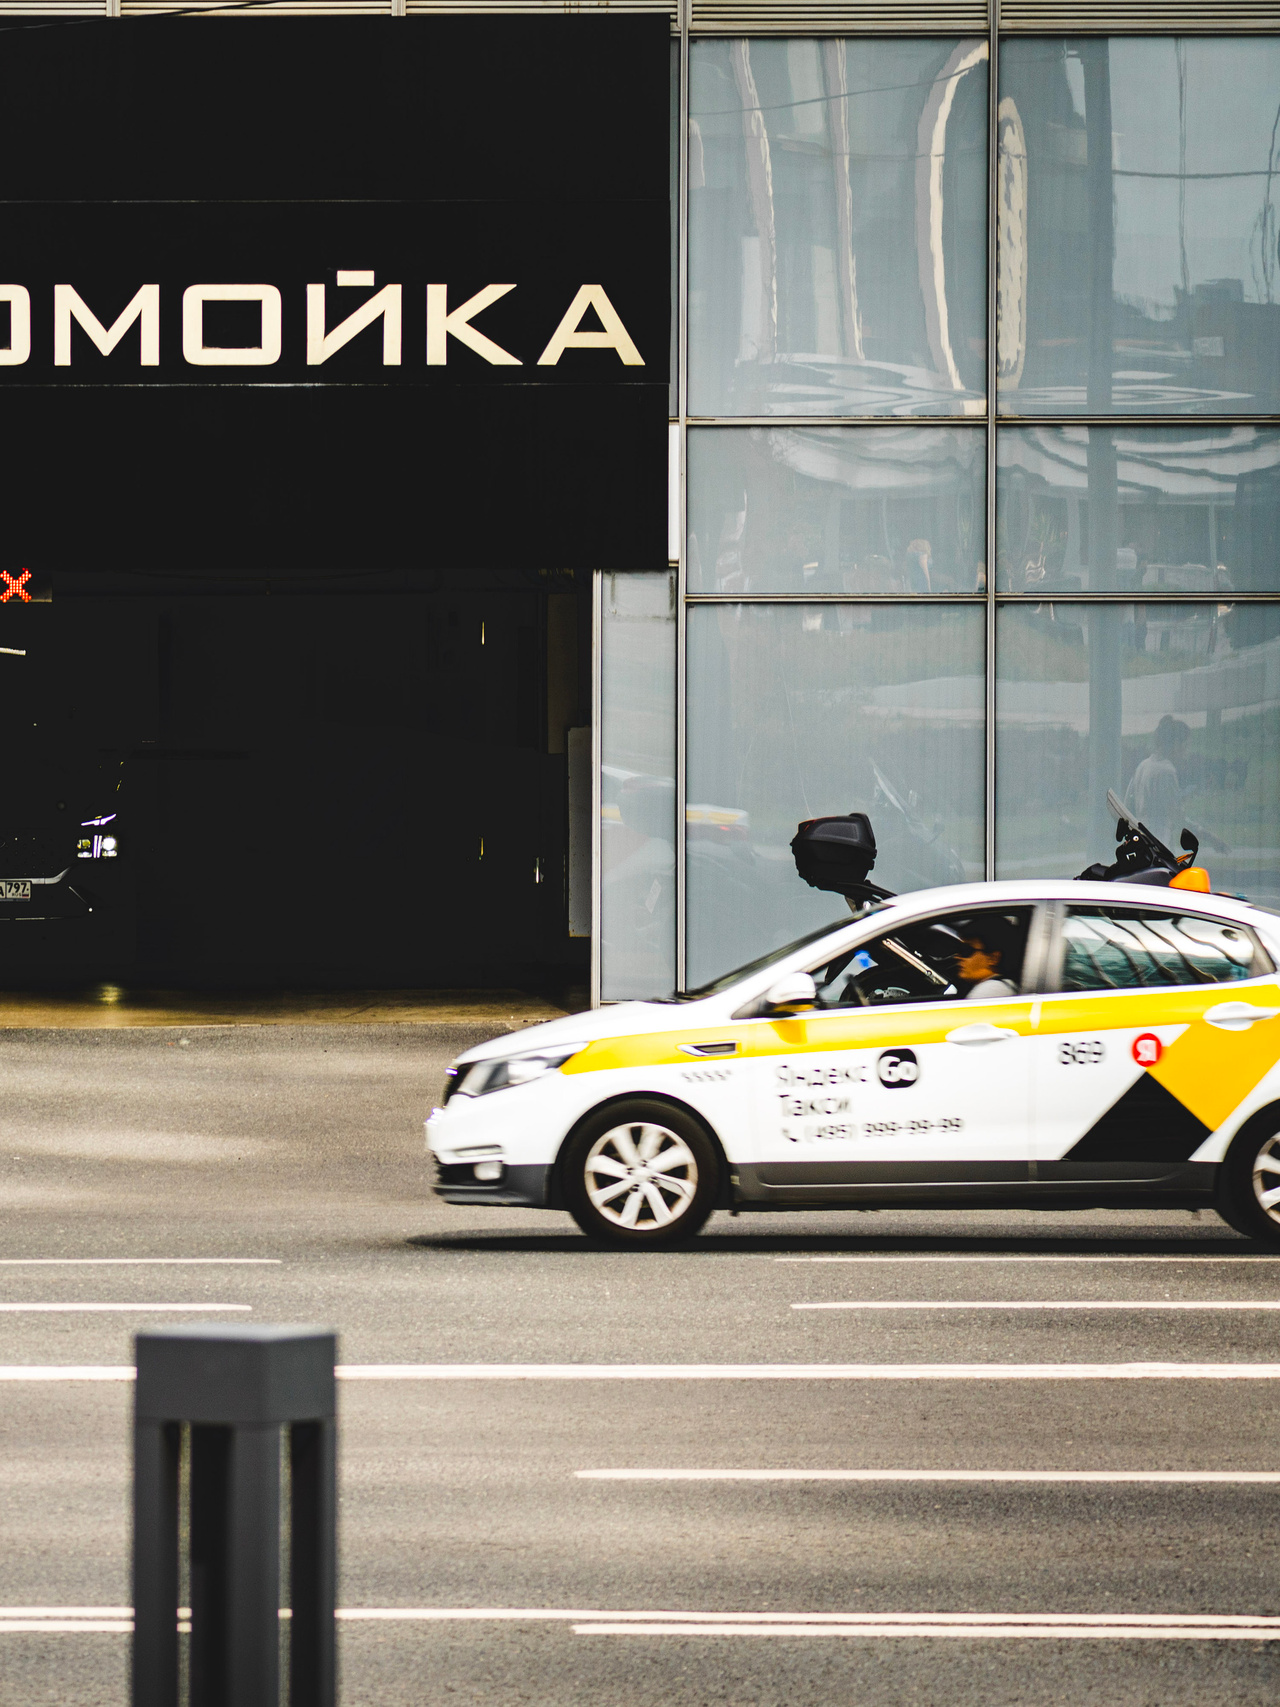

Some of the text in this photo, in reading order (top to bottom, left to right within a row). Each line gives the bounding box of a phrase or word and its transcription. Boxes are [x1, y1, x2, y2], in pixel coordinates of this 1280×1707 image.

[7, 882, 27, 893] 797
[1058, 1040, 1106, 1066] 869
[778, 1094, 852, 1117] Такси
